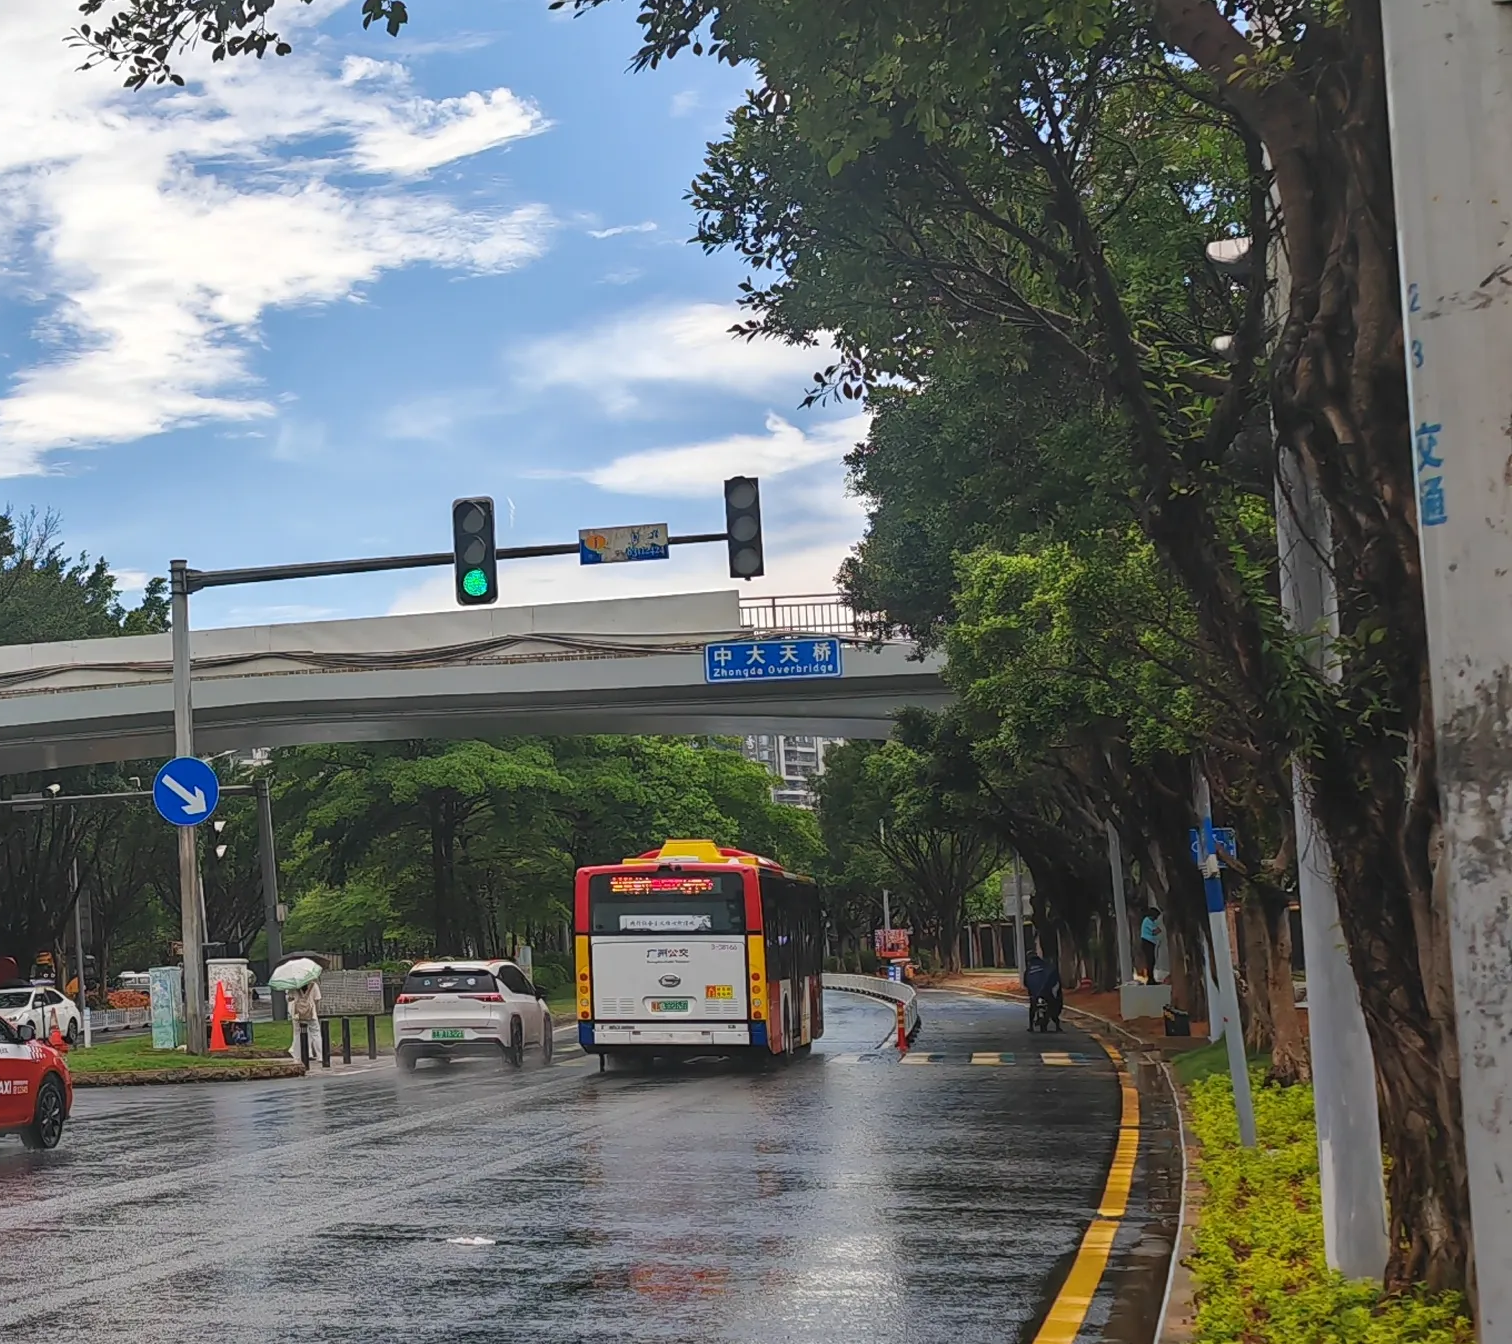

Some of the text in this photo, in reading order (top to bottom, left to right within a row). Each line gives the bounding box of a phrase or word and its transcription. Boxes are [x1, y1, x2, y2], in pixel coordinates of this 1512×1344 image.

[713, 642, 832, 667] 中大天桥
[713, 663, 834, 678] Zhongda Overbridge
[646, 948, 689, 959] 广州公交
